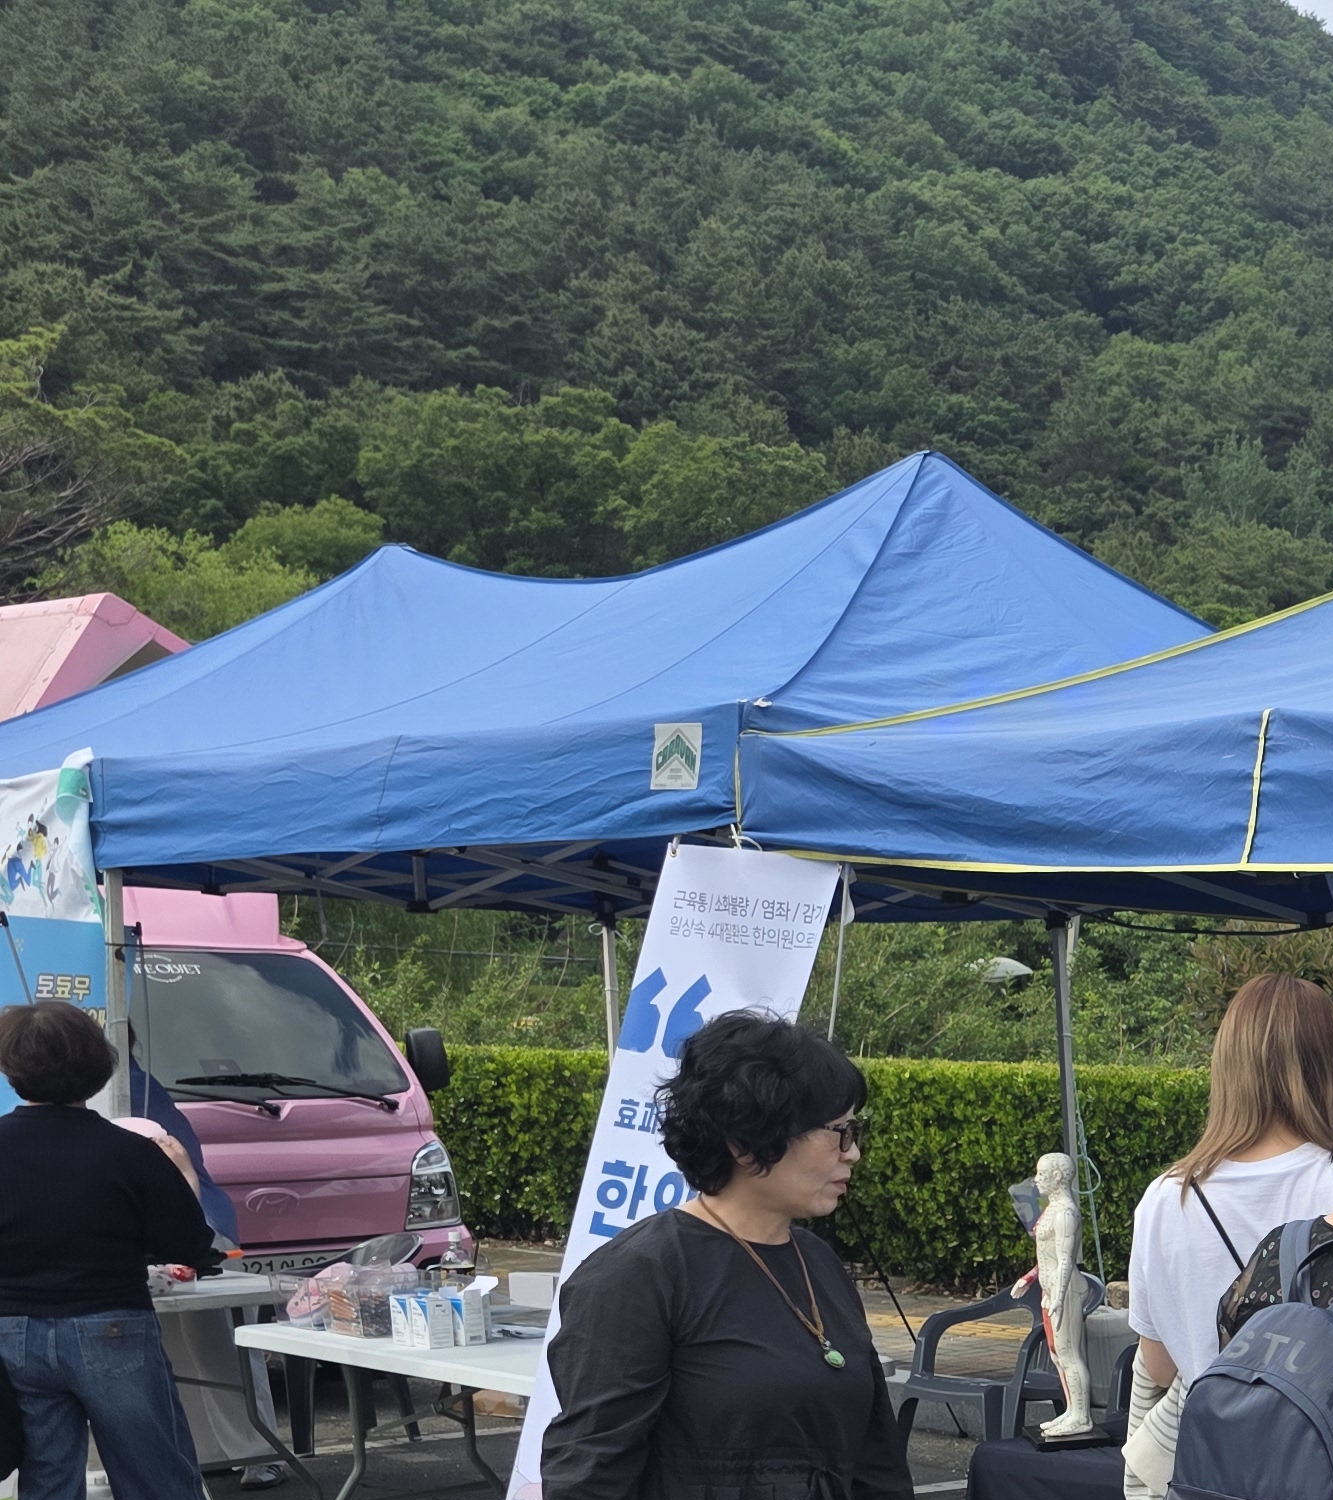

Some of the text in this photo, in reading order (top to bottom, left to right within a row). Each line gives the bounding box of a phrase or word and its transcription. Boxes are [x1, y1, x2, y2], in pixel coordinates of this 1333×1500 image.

[673, 890, 708, 913] 근육통
[714, 894, 750, 918] 소화불량
[761, 899, 791, 922] 염좌
[802, 903, 826, 924] 감기
[669, 915, 706, 939] 일상속
[707, 922, 750, 945] 4대질환은
